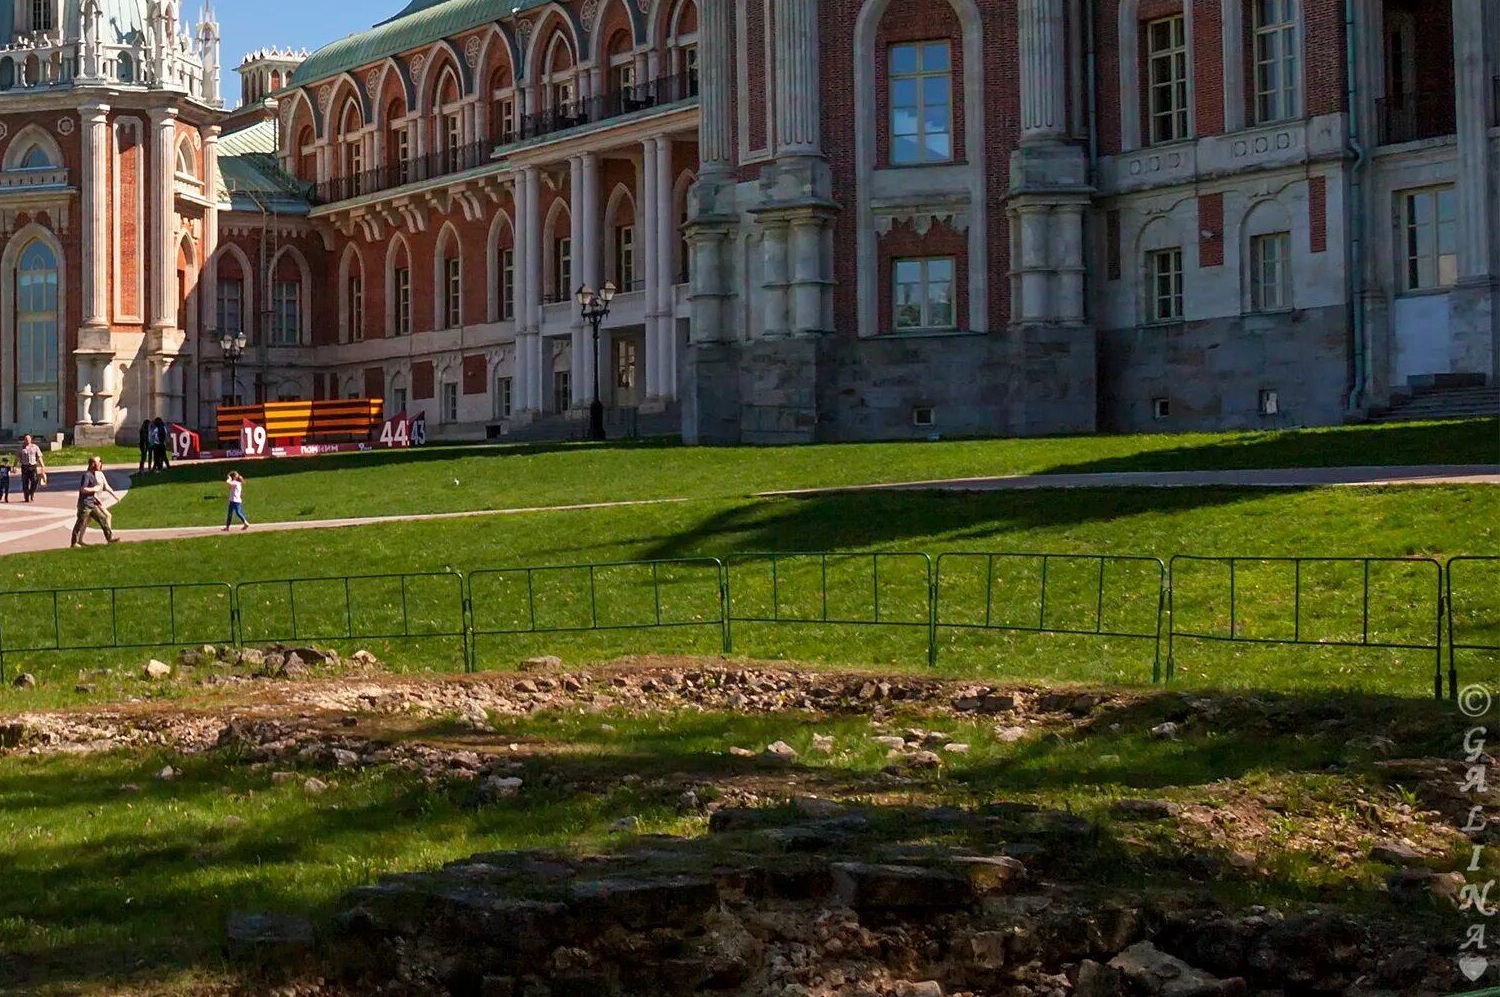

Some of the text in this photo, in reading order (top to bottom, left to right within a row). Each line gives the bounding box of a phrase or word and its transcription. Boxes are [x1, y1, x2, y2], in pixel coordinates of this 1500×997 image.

[170, 431, 191, 457] 19
[244, 426, 266, 454] 19
[379, 420, 406, 447] 44
[411, 420, 426, 445] 43
